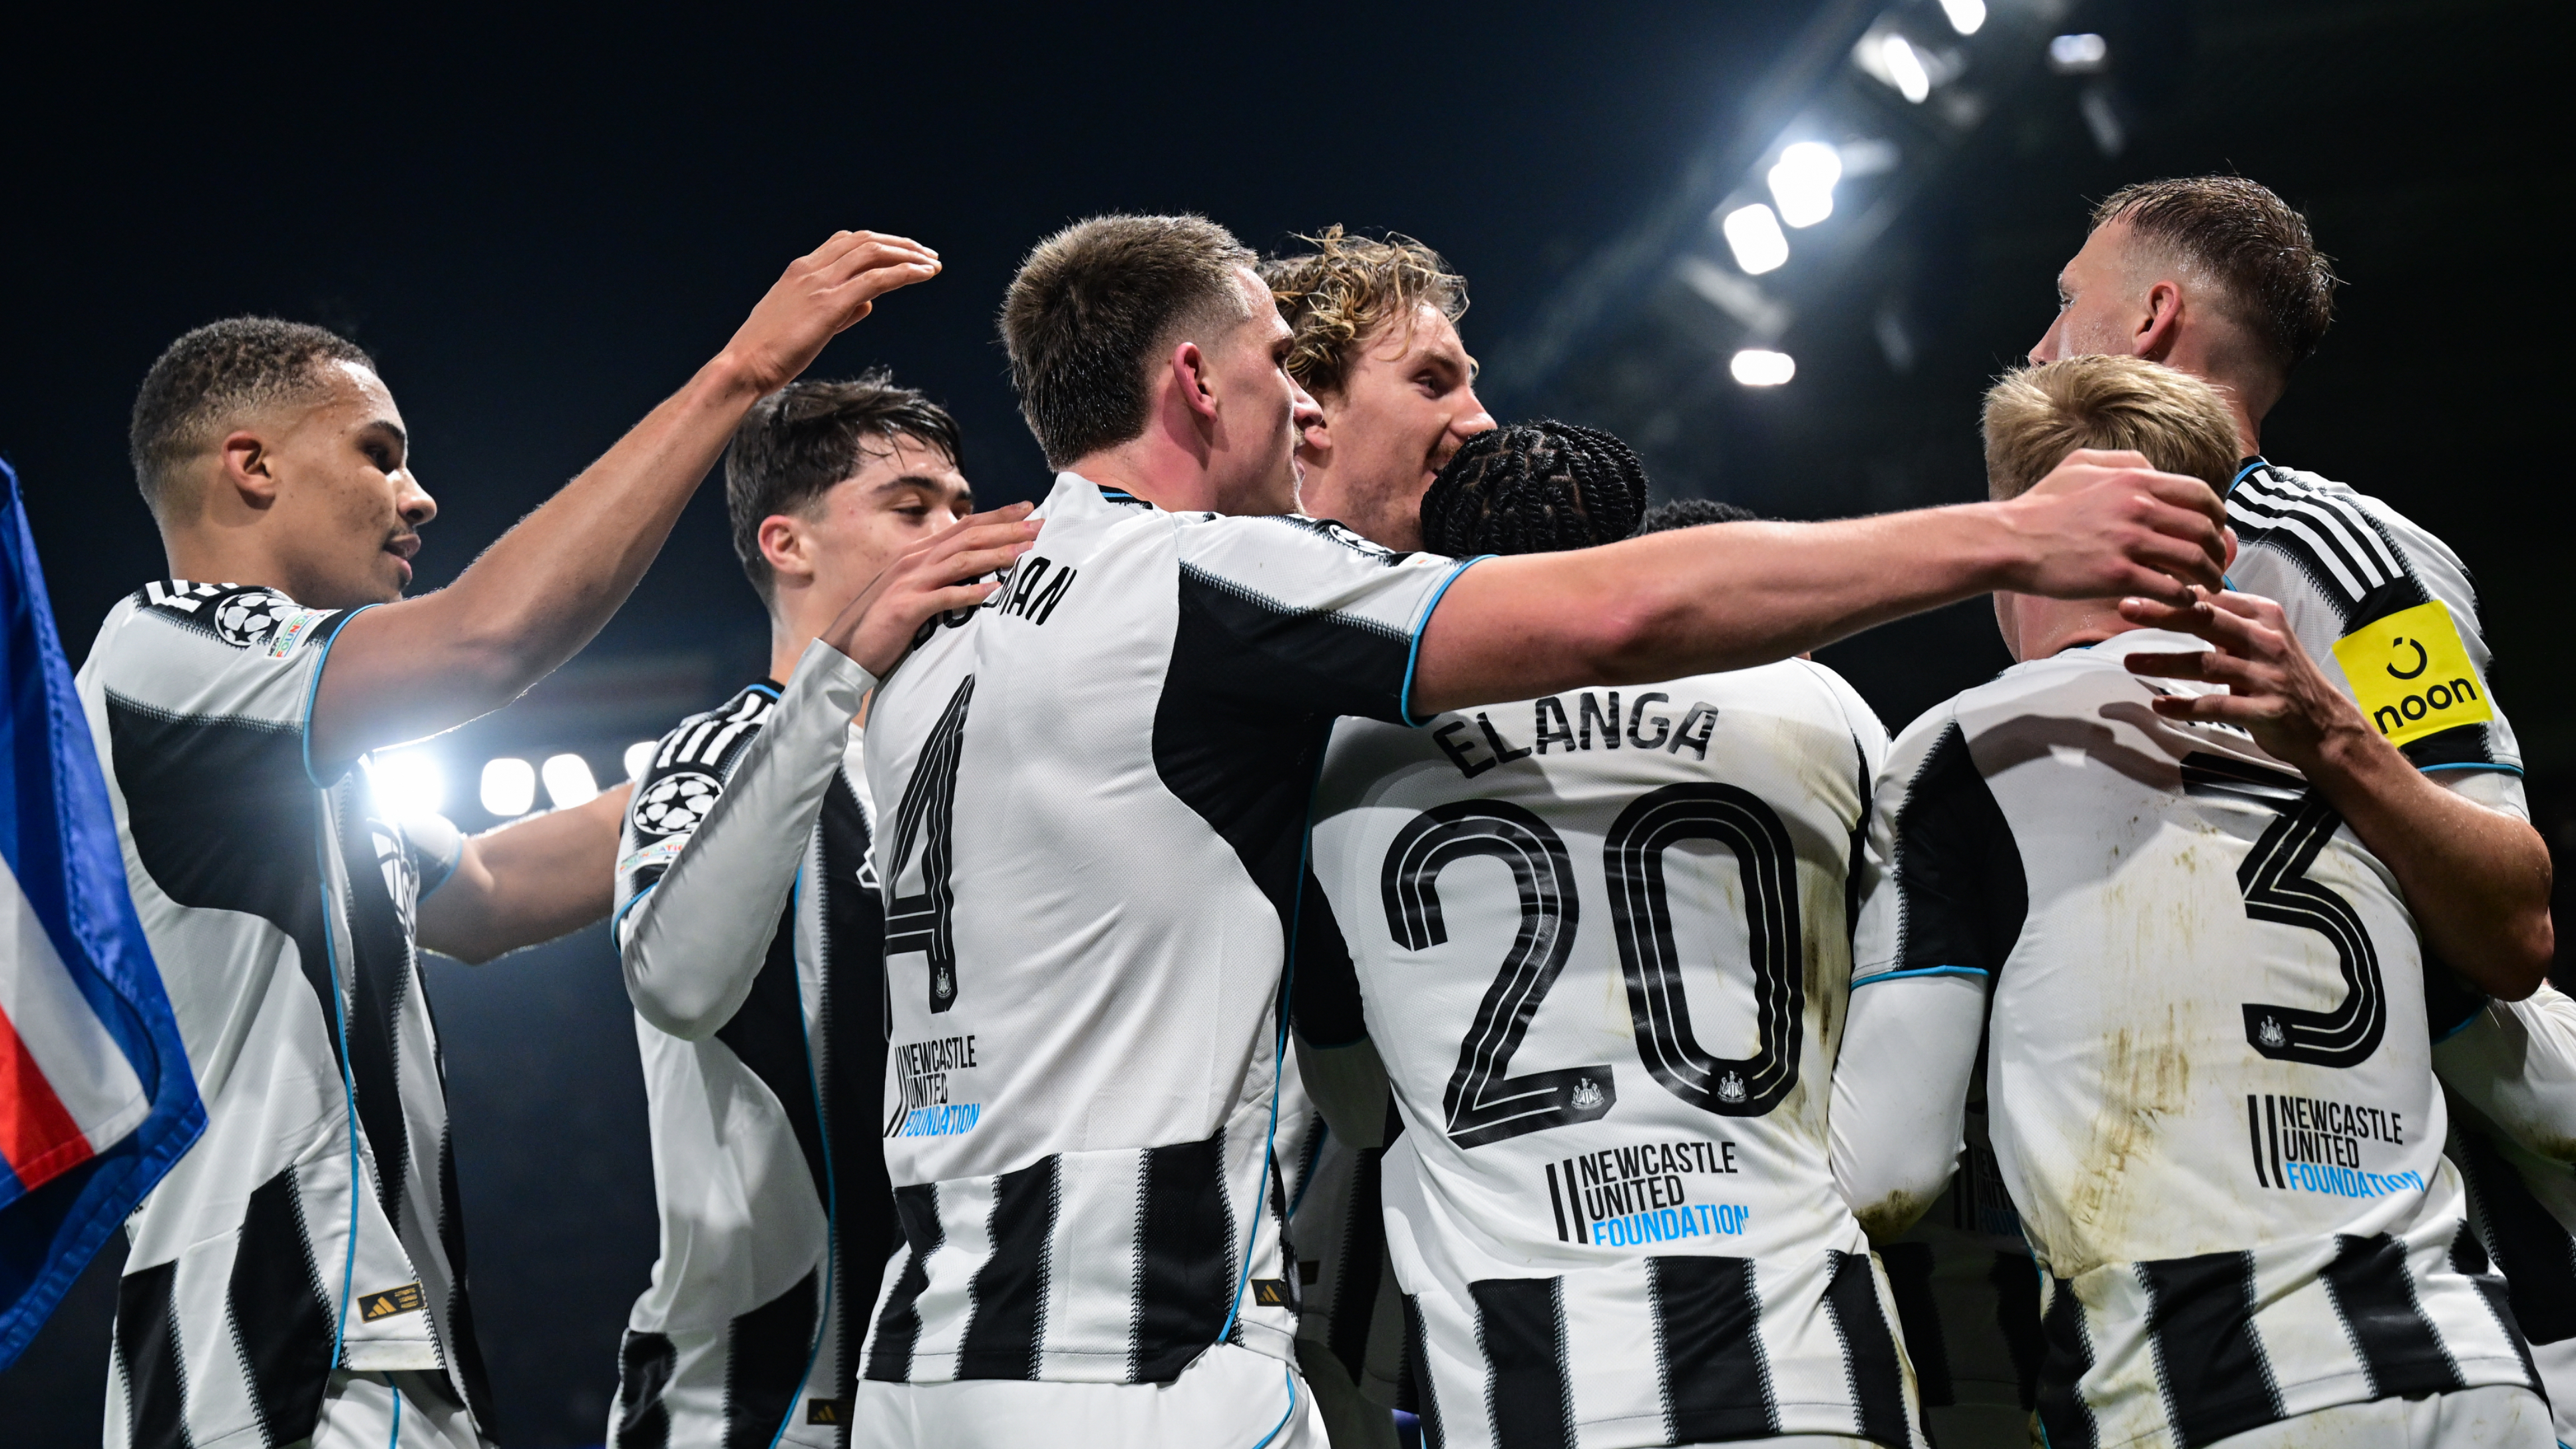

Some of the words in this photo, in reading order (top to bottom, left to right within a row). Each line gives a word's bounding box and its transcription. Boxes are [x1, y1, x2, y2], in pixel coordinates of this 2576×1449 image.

[2373, 678, 2478, 735] noon
[1433, 691, 1719, 779] ELANGA
[885, 672, 976, 1014] 4
[2179, 751, 2386, 1068] 3
[1381, 781, 1805, 1150] 20
[902, 1035, 977, 1076] NEWCASTLE
[906, 1072, 948, 1110] UNITED
[899, 1103, 980, 1138] FOUNDATION
[2279, 1095, 2404, 1145] NEWCASTLE
[1578, 1141, 1738, 1188] NEWCASTLE
[2283, 1129, 2360, 1169] UNITED
[1584, 1175, 1685, 1221] UNITED
[2285, 1162, 2425, 1198] FOUNDATION
[1592, 1204, 1749, 1247] FOUNDATION
